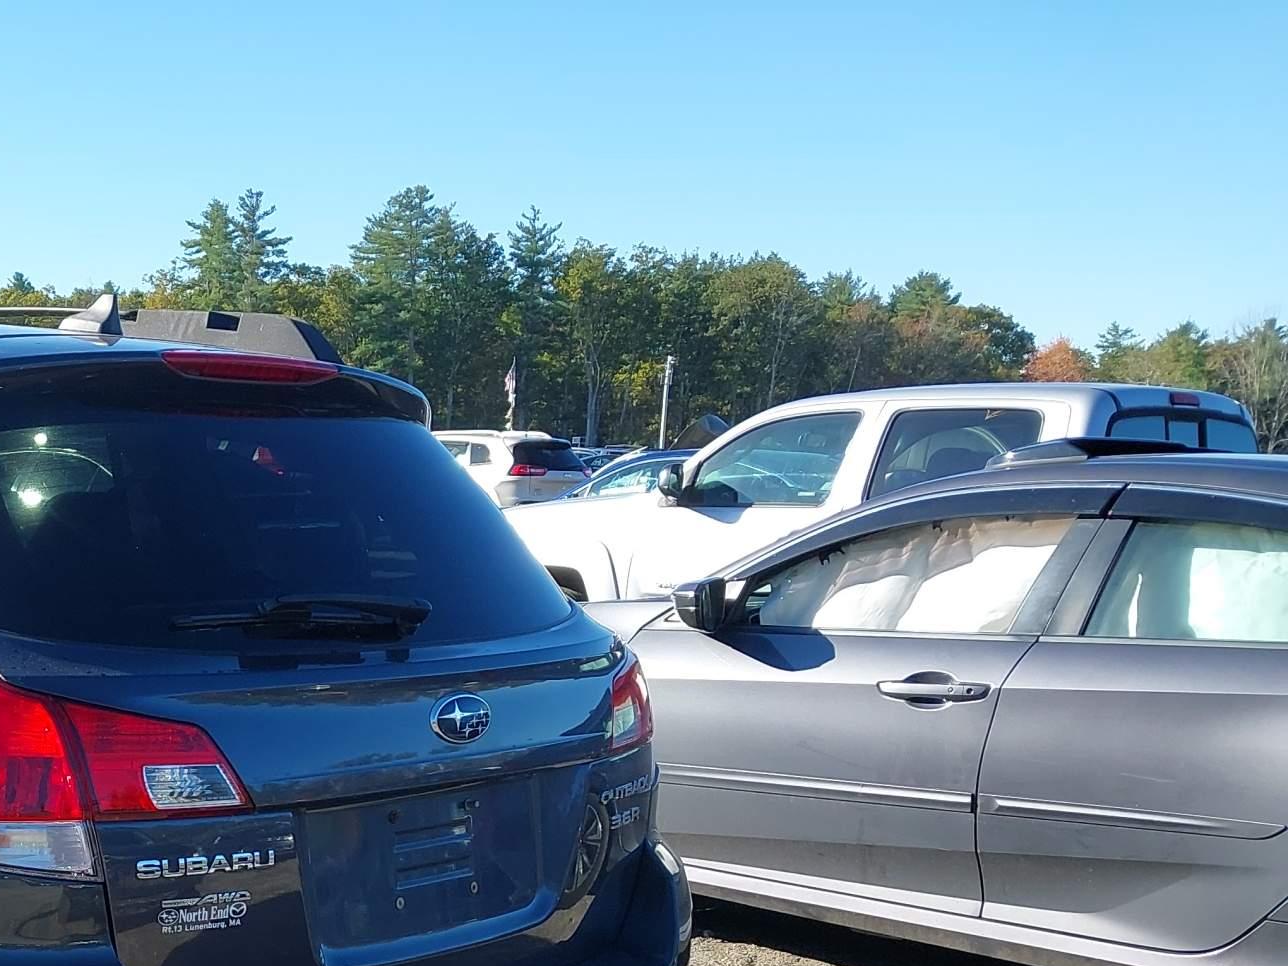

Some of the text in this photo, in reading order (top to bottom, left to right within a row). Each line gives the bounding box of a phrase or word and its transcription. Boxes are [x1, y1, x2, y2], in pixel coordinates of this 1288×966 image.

[136, 850, 275, 879] SUBARU
[198, 890, 251, 905] AWD
[179, 905, 229, 923] North End
[229, 918, 241, 926] MA
